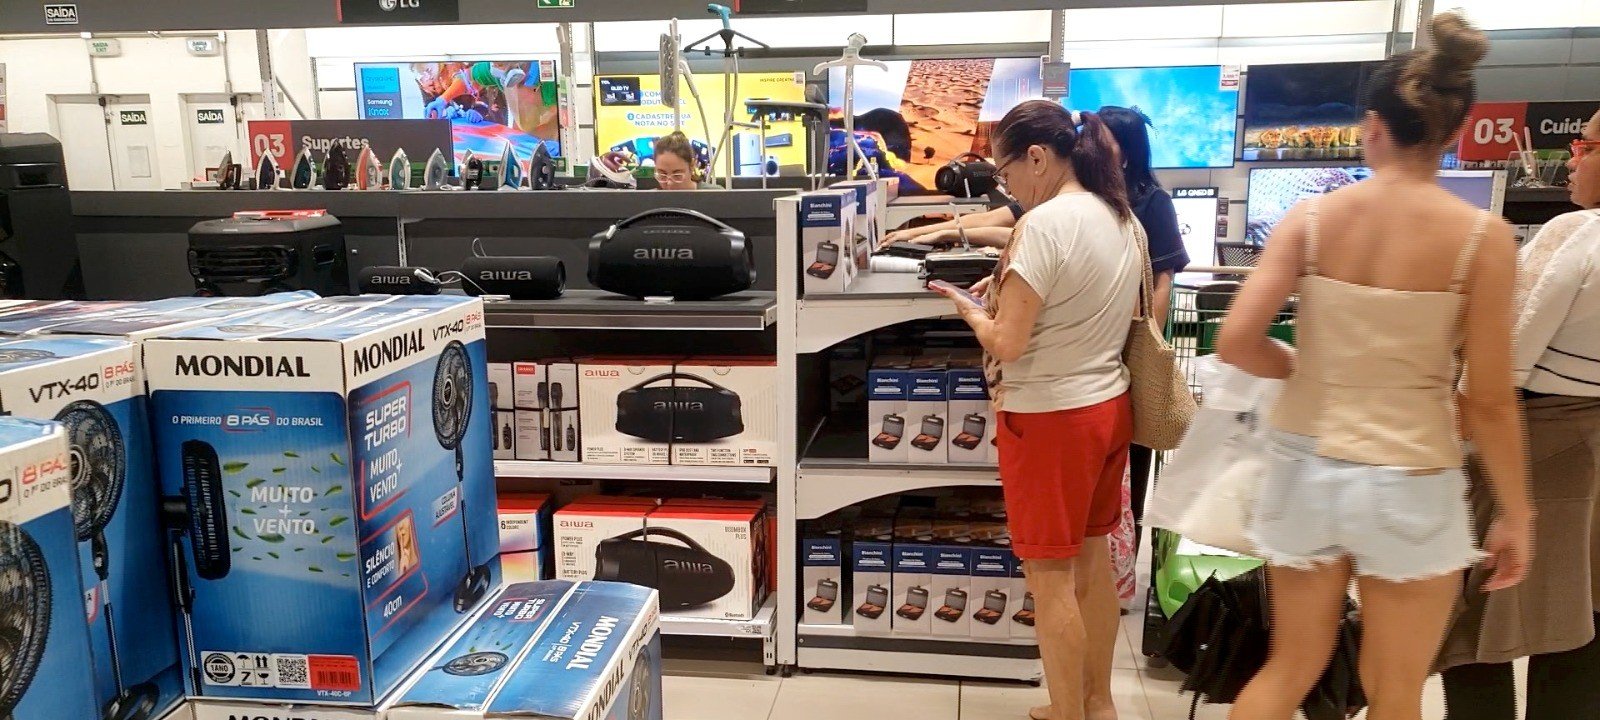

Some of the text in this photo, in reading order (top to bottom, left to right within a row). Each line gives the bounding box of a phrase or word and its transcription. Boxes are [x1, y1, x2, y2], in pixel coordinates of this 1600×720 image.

[47, 6, 75, 18] SAÍDA
[121, 113, 146, 122] SAÍDA
[198, 111, 223, 121] SAÍDA
[1474, 118, 1515, 144] 03
[254, 134, 285, 157] 03
[633, 248, 693, 259] aiwa
[371, 275, 411, 285] aiwa
[480, 269, 532, 281] aiwa
[433, 320, 464, 341] VTX-40
[353, 328, 425, 377] MONDIAL
[104, 361, 135, 379] 8 PÁS
[175, 355, 311, 377] MONDIAL
[29, 373, 99, 403] VTX-40
[366, 395, 406, 430] SUPER
[654, 401, 703, 411] aiwa
[172, 413, 323, 426] O PRIMEIRO 8 PÁS DO BRASIL
[364, 415, 406, 451] TURBO
[22, 464, 37, 485] 8
[370, 448, 397, 480] MUITO
[252, 486, 314, 504] MUITO
[370, 472, 397, 503] VENTO
[254, 518, 315, 535] VENTO
[366, 541, 395, 574] SILÊNCIO
[664, 559, 713, 574] aiwa
[383, 595, 402, 617] 40cm
[566, 616, 619, 670] MONDIAL
